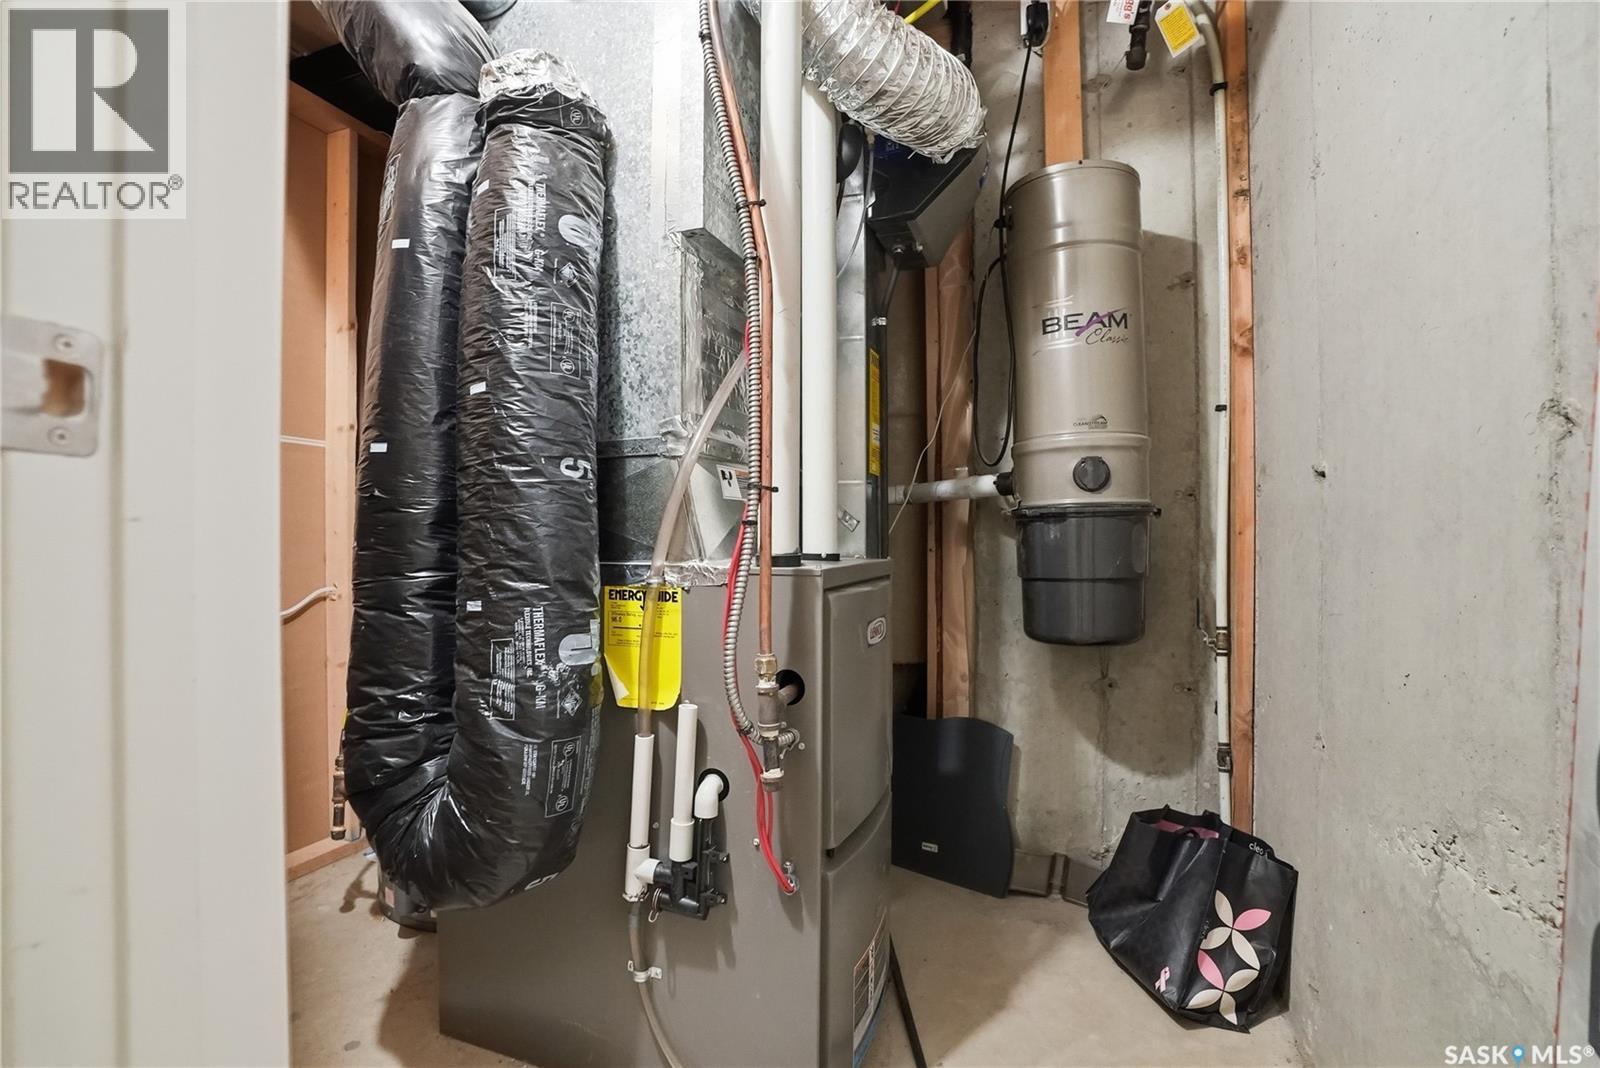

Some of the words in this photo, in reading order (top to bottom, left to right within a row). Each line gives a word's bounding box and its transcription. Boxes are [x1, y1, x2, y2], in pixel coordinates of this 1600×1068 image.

[1042, 312, 1129, 335] BEAM
[1085, 327, 1129, 345] Classic
[532, 606, 546, 666] THERMAFLEX
[1249, 842, 1264, 855] cleo
